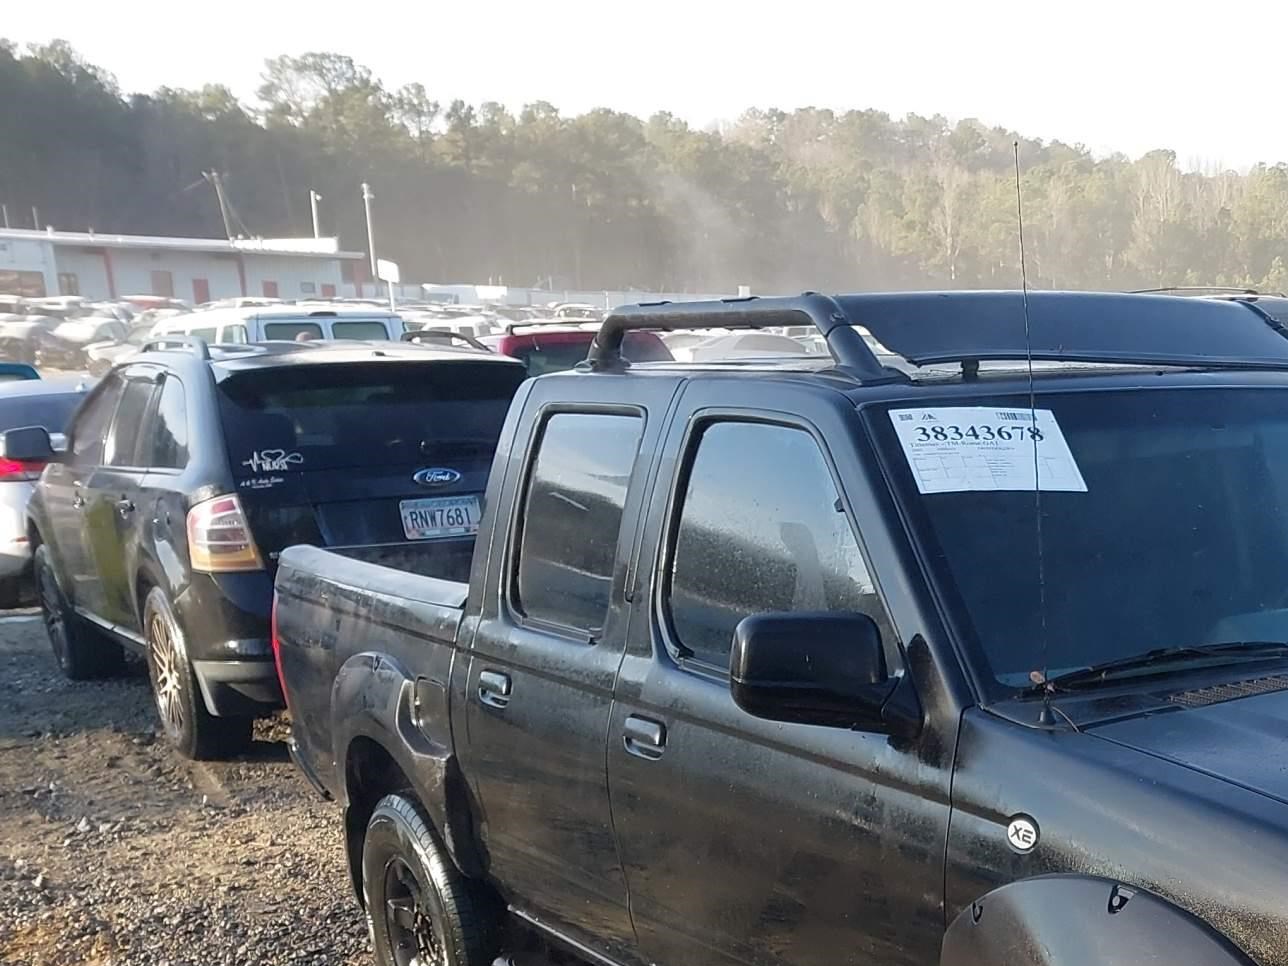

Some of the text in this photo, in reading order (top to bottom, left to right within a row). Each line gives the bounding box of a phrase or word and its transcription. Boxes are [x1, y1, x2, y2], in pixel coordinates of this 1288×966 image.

[914, 425, 1044, 441] 38343678
[409, 507, 471, 529] RNW7681
[1010, 825, 1034, 844] XE
